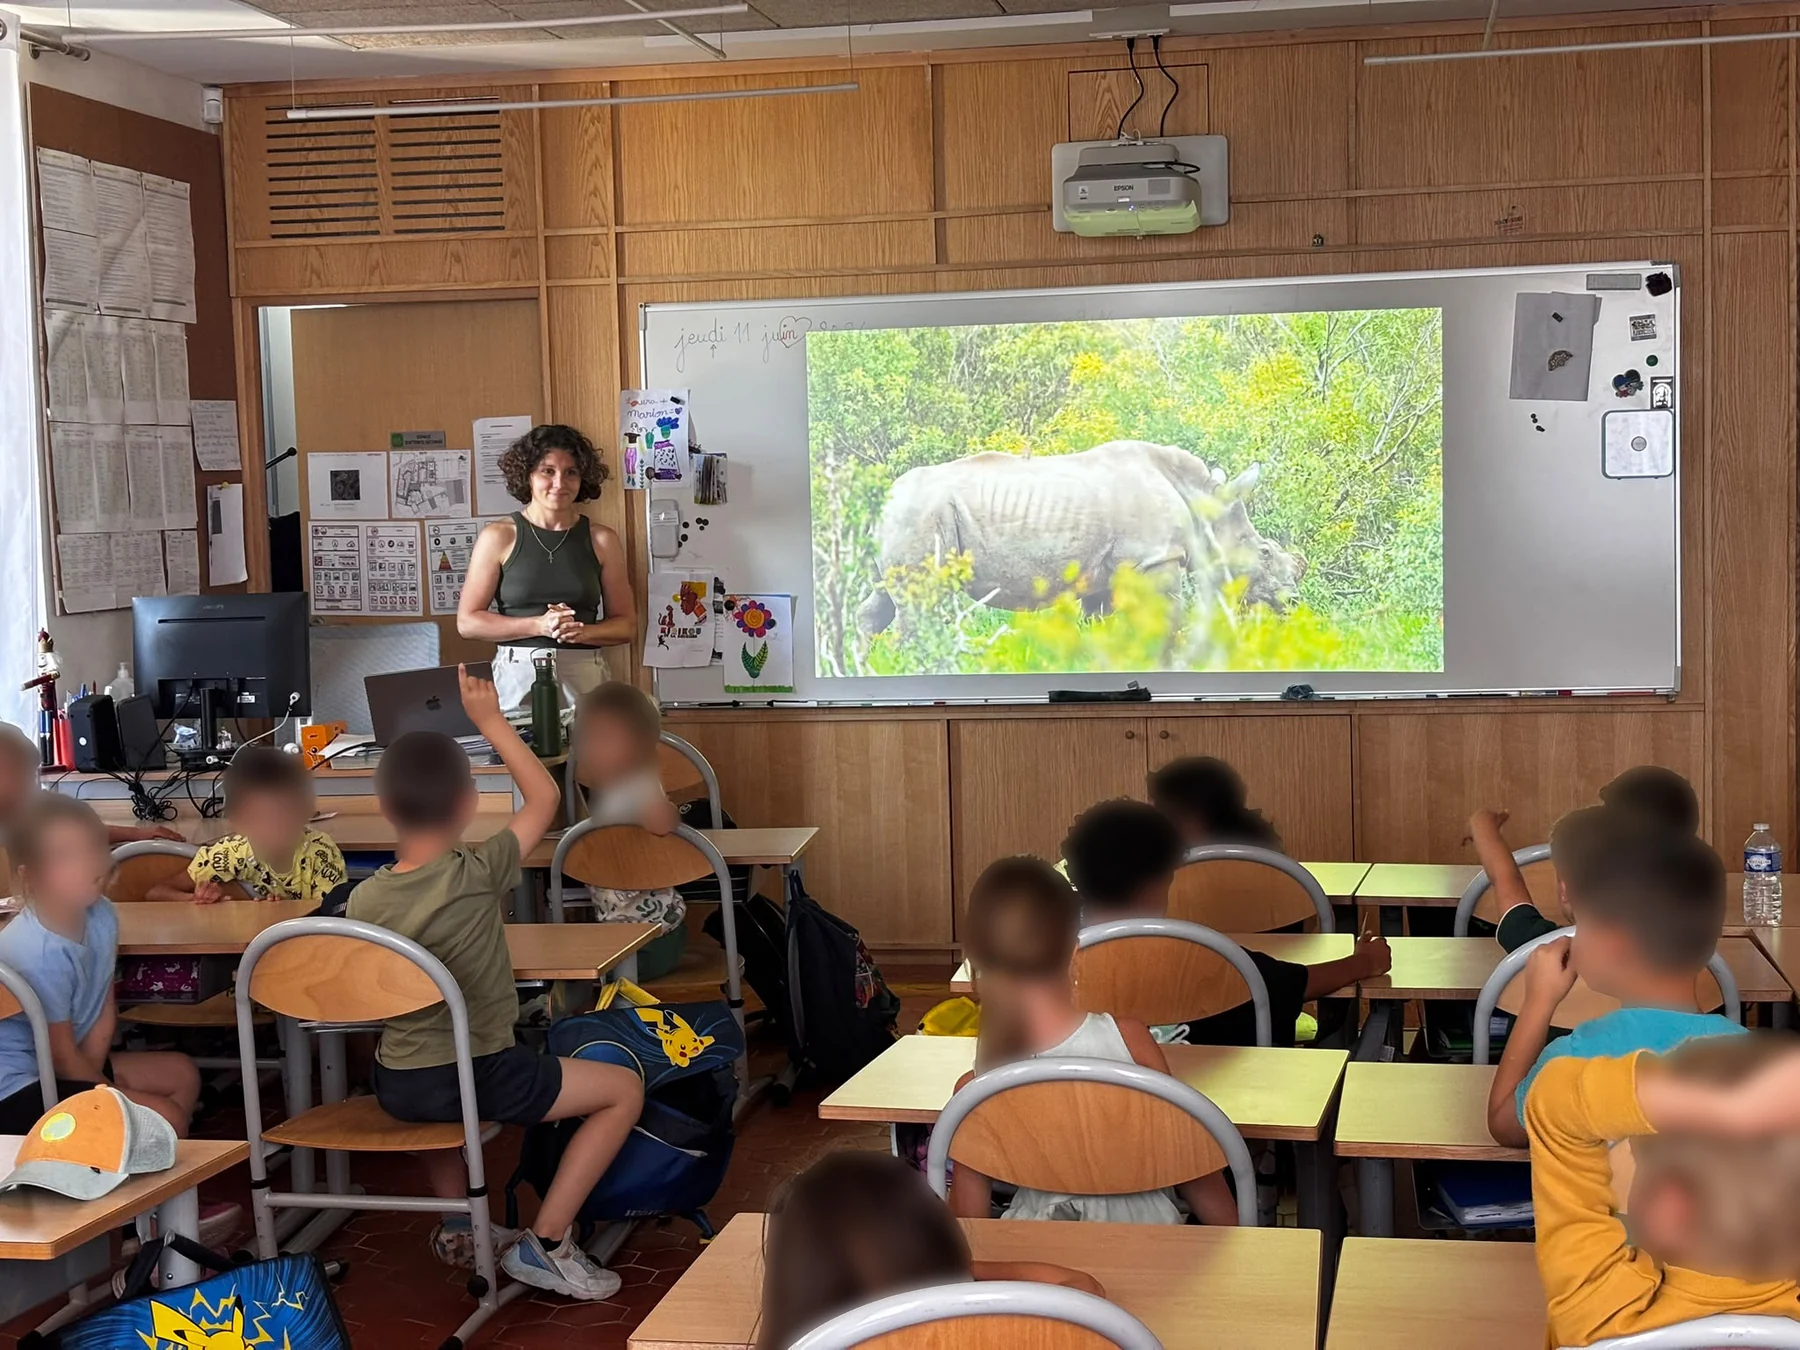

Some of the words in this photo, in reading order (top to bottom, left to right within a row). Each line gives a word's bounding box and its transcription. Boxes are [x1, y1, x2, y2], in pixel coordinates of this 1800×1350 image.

[674, 317, 727, 373] jeudi
[732, 321, 750, 344] 11
[761, 323, 798, 364] juin
